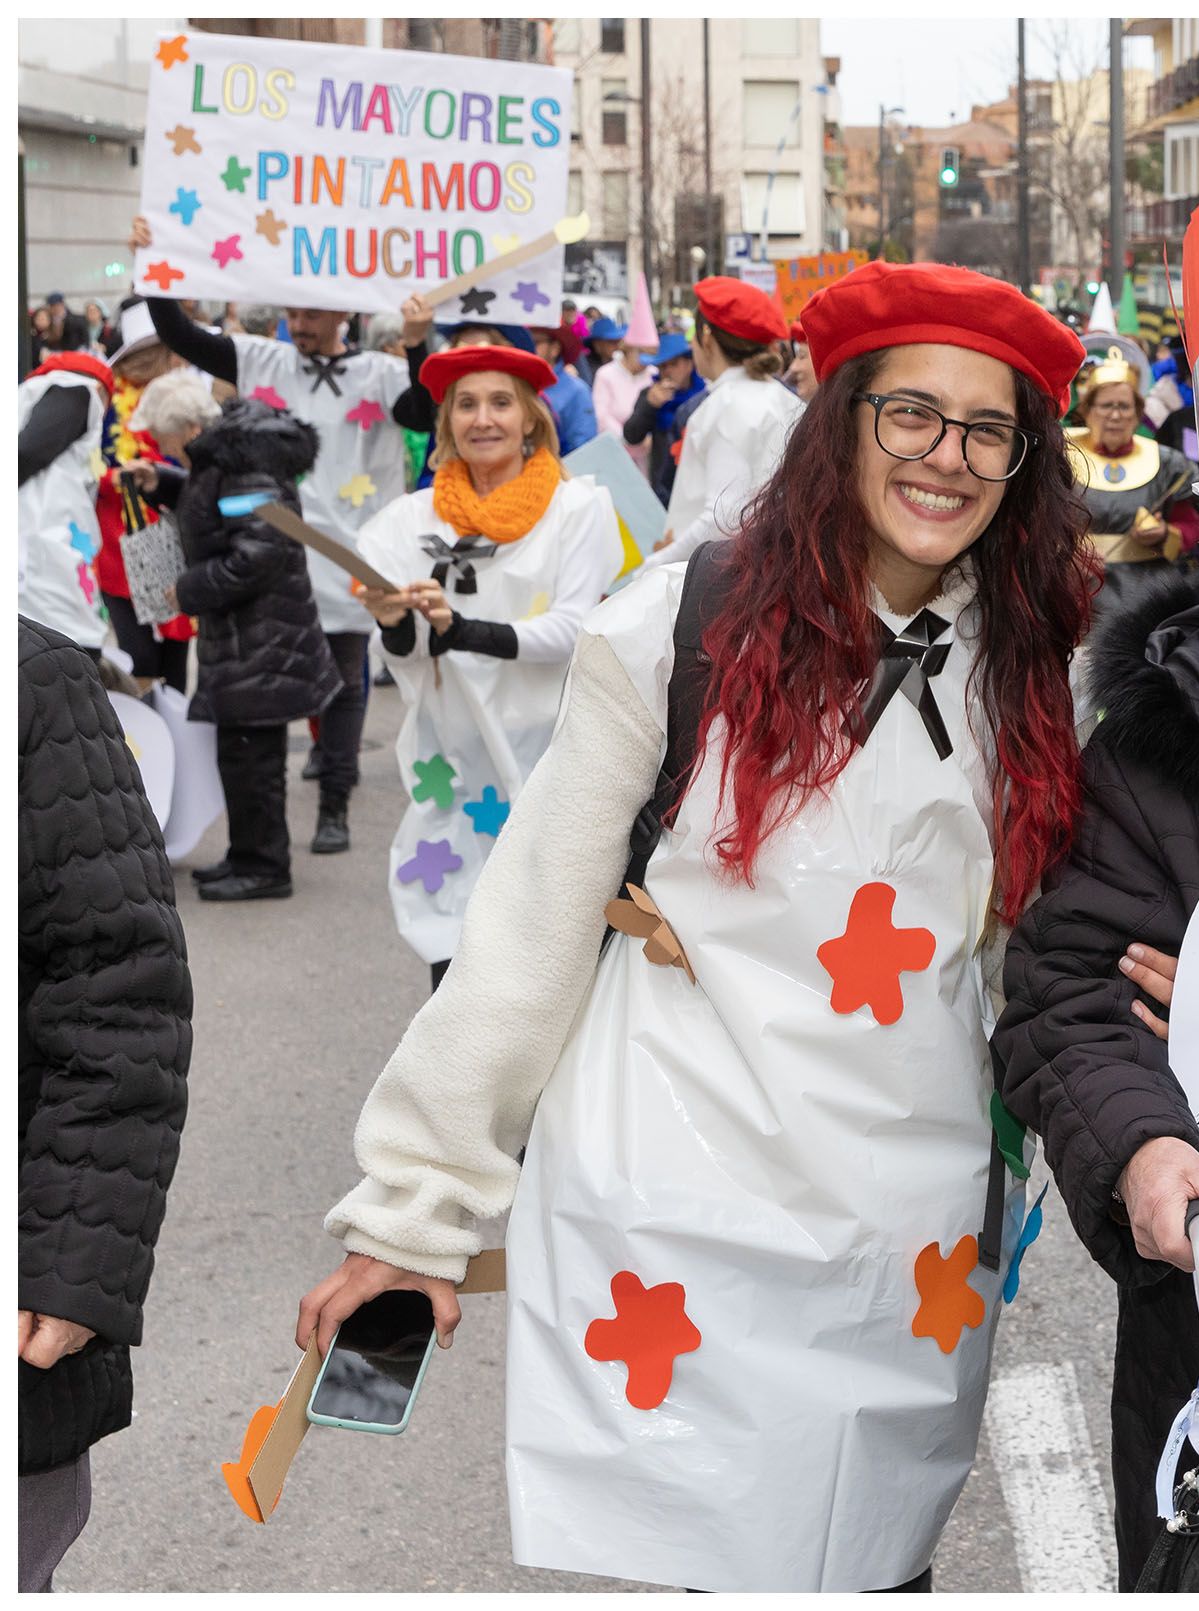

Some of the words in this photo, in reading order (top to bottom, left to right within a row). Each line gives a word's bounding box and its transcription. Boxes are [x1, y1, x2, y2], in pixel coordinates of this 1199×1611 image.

[192, 62, 297, 120] LOS
[315, 78, 562, 149] MAYORES
[257, 150, 537, 213] PINTAMOS
[292, 226, 486, 280] MUCHO
